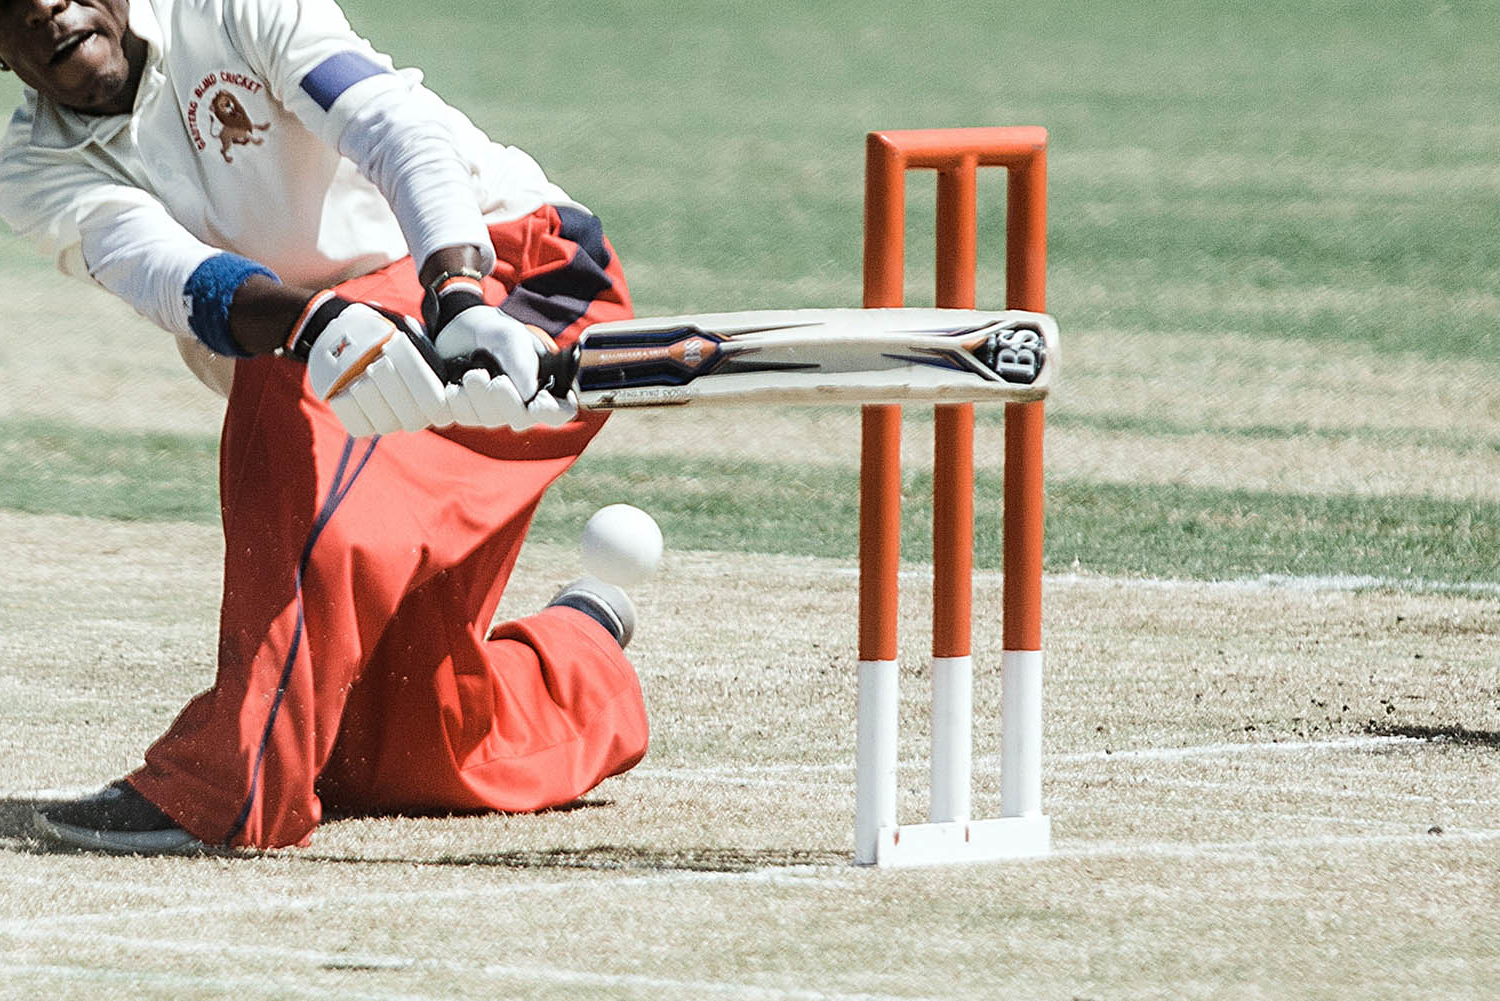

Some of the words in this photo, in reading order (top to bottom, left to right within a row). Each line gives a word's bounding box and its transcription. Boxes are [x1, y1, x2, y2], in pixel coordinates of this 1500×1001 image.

[194, 73, 217, 98] BLIND
[220, 71, 262, 95] CRICKET
[996, 329, 1040, 376] BS
